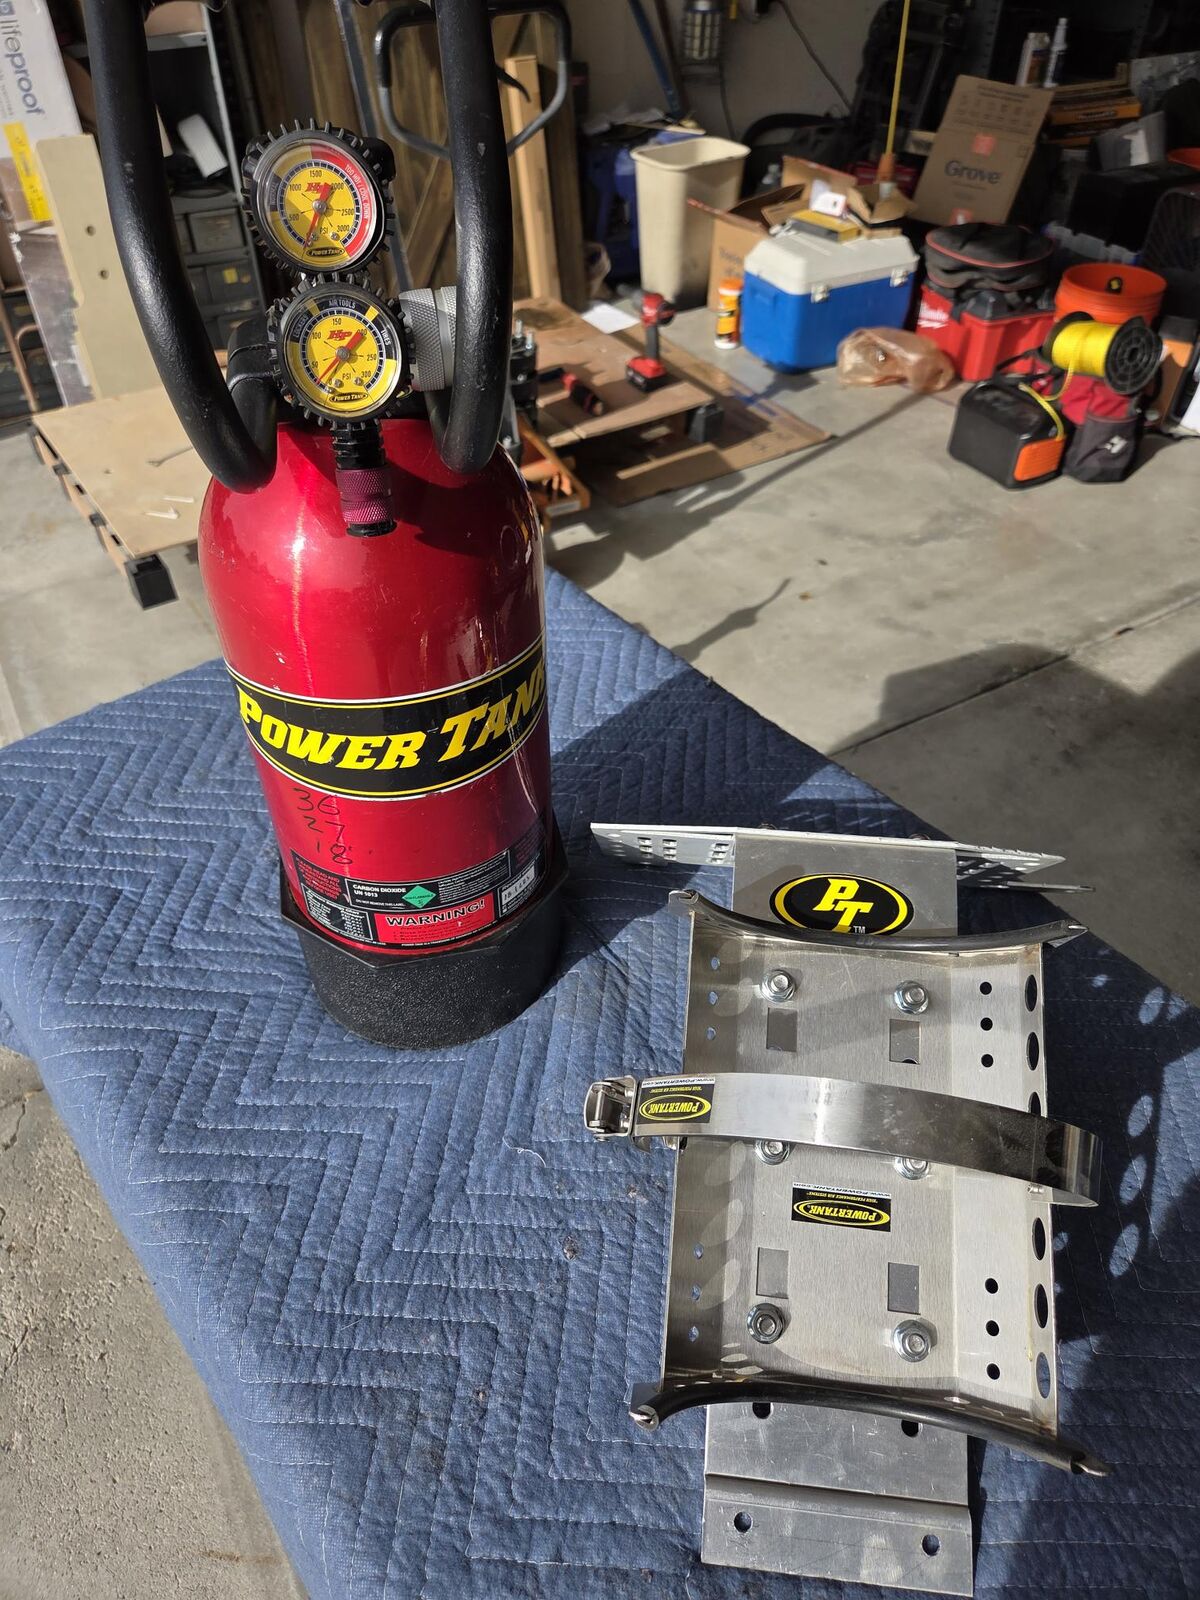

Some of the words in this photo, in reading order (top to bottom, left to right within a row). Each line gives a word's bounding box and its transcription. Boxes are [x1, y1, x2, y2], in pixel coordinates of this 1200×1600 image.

[0, 19, 45, 114] lifeproof
[309, 169, 322, 178] 1500
[944, 160, 1000, 184] Grove
[289, 183, 302, 192] 1000
[341, 208, 354, 217] 2500
[289, 213, 300, 222] 500
[320, 226, 329, 235] PSI
[336, 224, 350, 233] 3000
[328, 299, 340, 308] AIR
[340, 299, 356, 310] TOOLS
[332, 317, 342, 326] 150
[311, 331, 322, 340] 100
[380, 328, 392, 346] TIRES
[366, 353, 377, 361] 250
[311, 361, 319, 369] 50
[341, 372, 352, 381] PSI
[360, 370, 372, 379] 300
[334, 394, 351, 402] POWER
[235, 683, 428, 771] POWER
[293, 787, 341, 816] 36
[353, 884, 380, 893] CARBON
[385, 898, 486, 927] WARNING!
[648, 1101, 701, 1114] POWERTANK
[809, 1205, 878, 1222] POWERTANK
